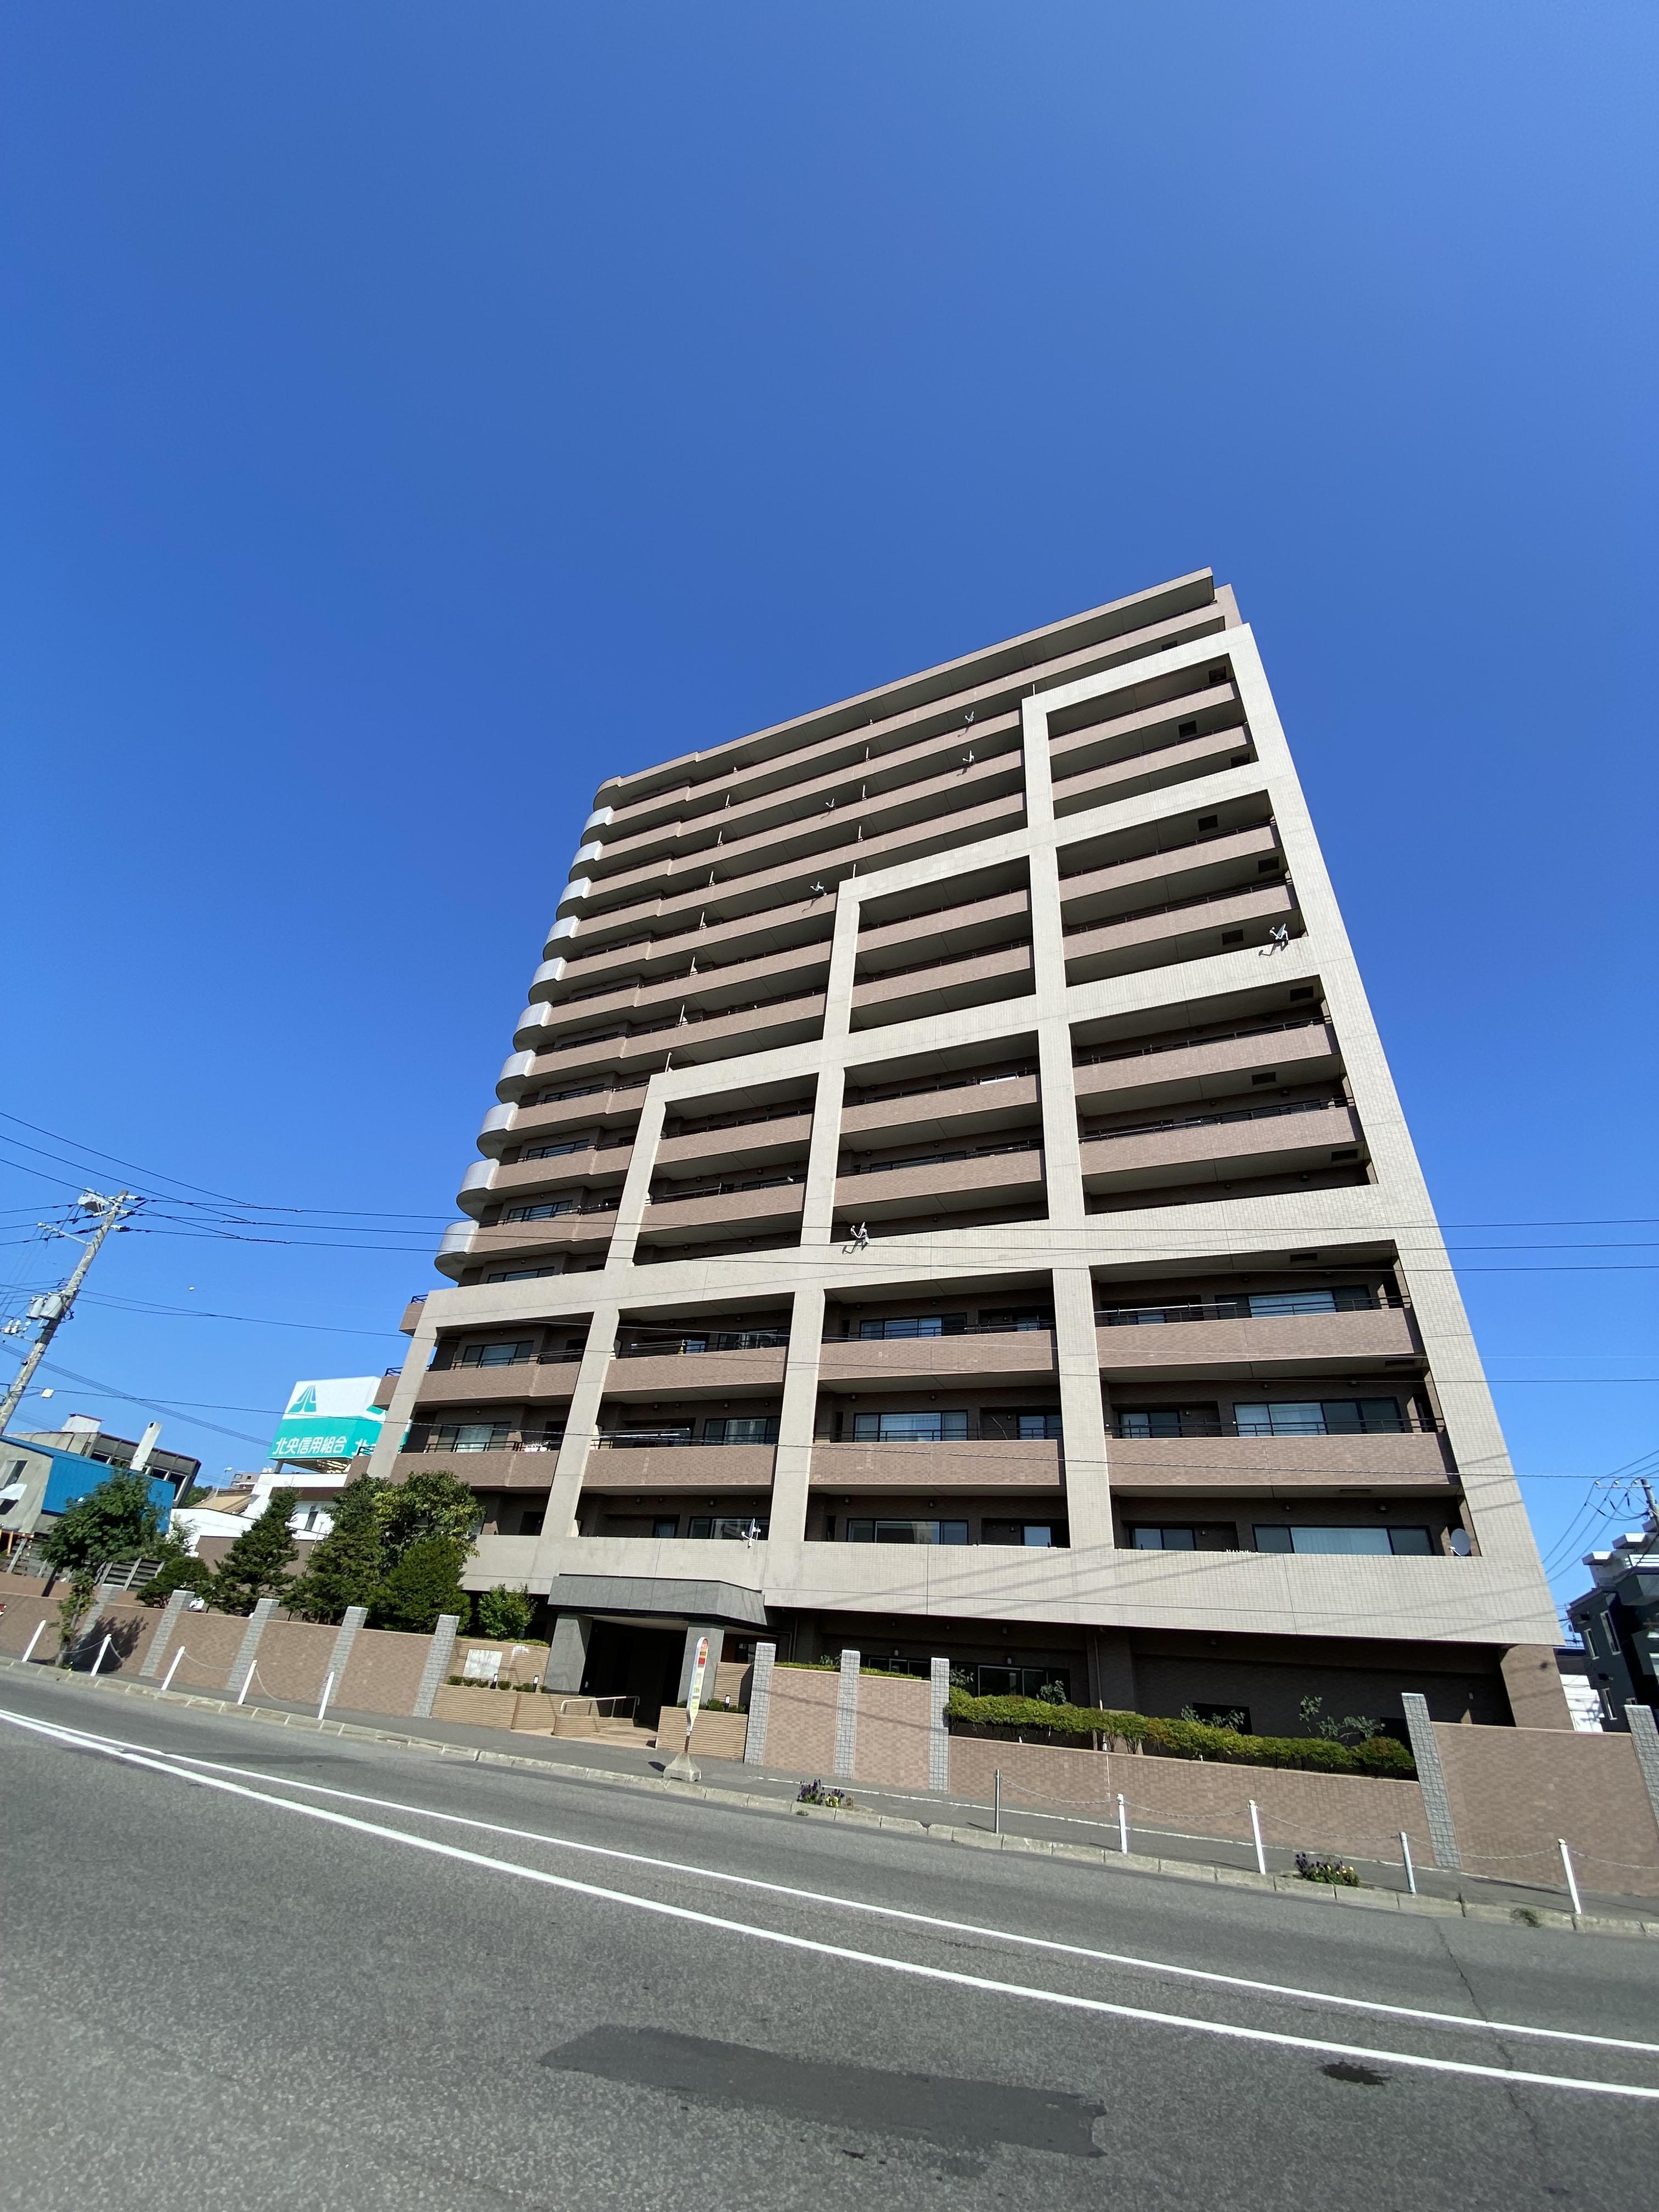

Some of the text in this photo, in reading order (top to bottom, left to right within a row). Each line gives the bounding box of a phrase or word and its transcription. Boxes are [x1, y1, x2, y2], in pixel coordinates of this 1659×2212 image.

[272, 1436, 347, 1454] 北央信用組合
